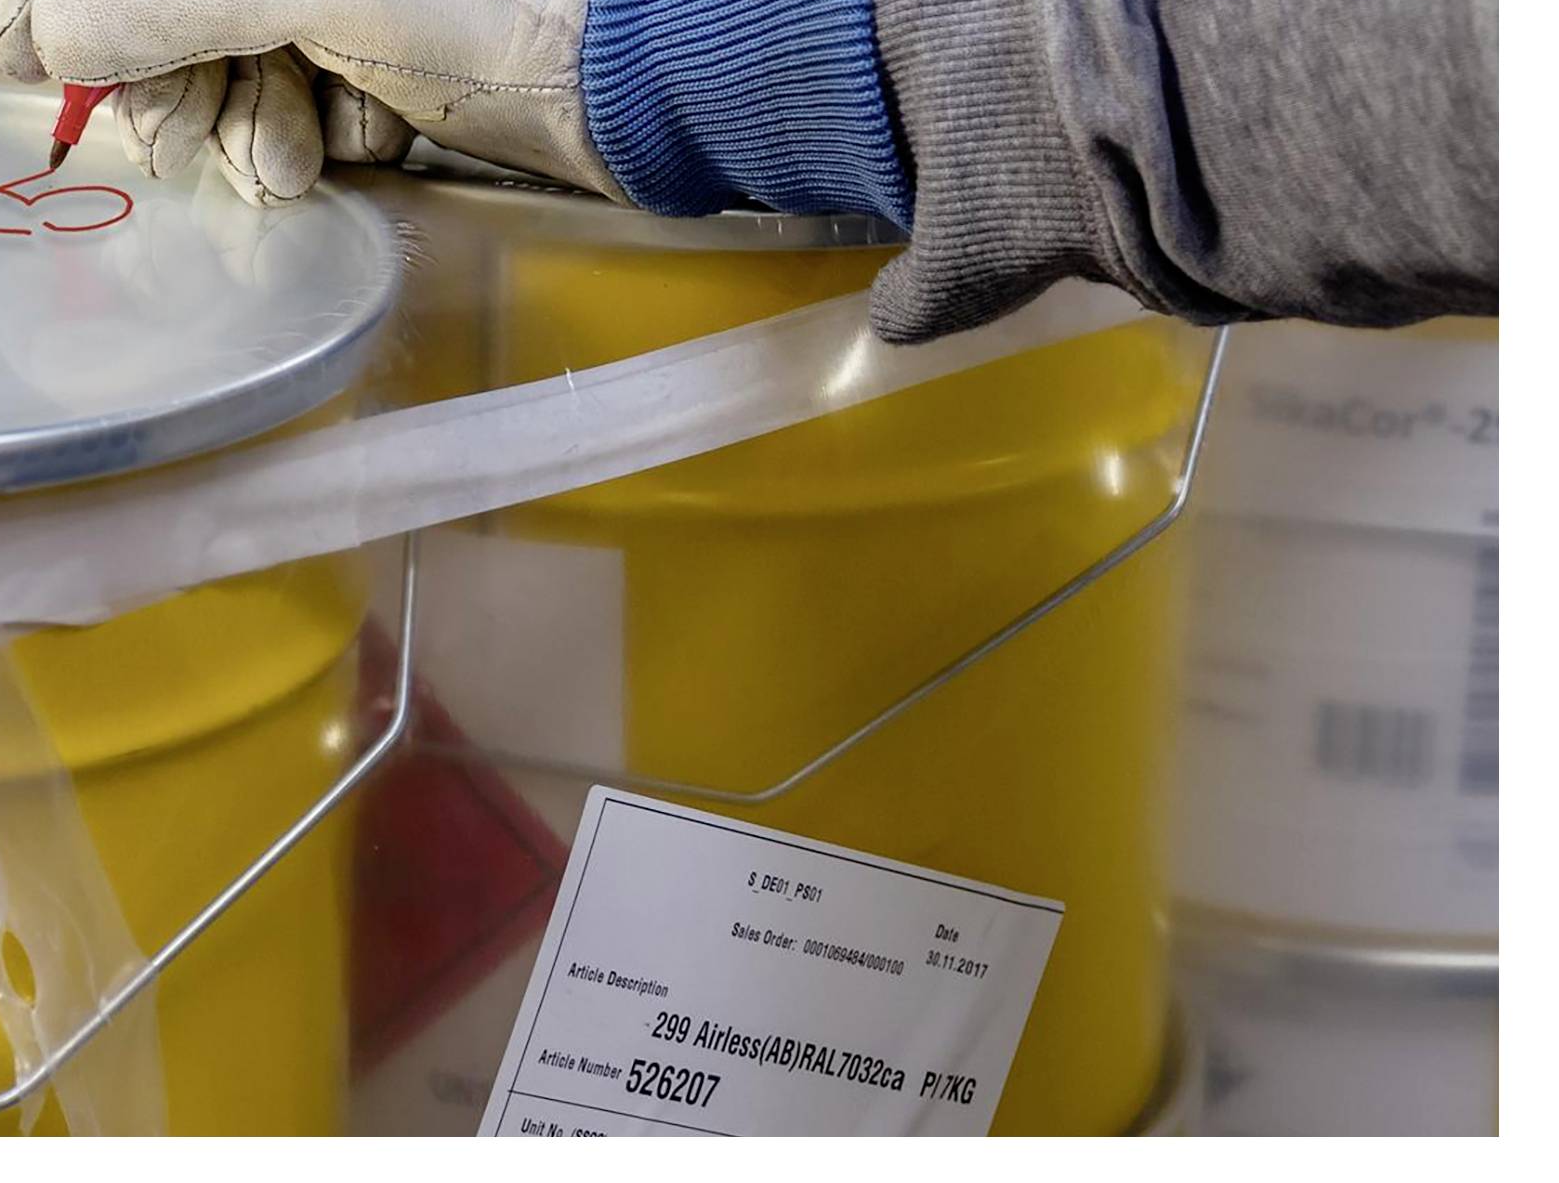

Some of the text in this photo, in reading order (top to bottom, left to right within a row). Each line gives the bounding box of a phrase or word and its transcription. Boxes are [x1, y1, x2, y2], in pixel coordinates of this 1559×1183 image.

[747, 871, 824, 904] S_DE01_PS01
[731, 921, 761, 943] Sales
[763, 929, 798, 952] Order:
[934, 923, 960, 944] Date
[925, 949, 989, 980] 30.11.2017
[567, 962, 670, 999] Article Description
[538, 1048, 721, 1109] Article Number 526207
[520, 1117, 545, 1137] Unit
